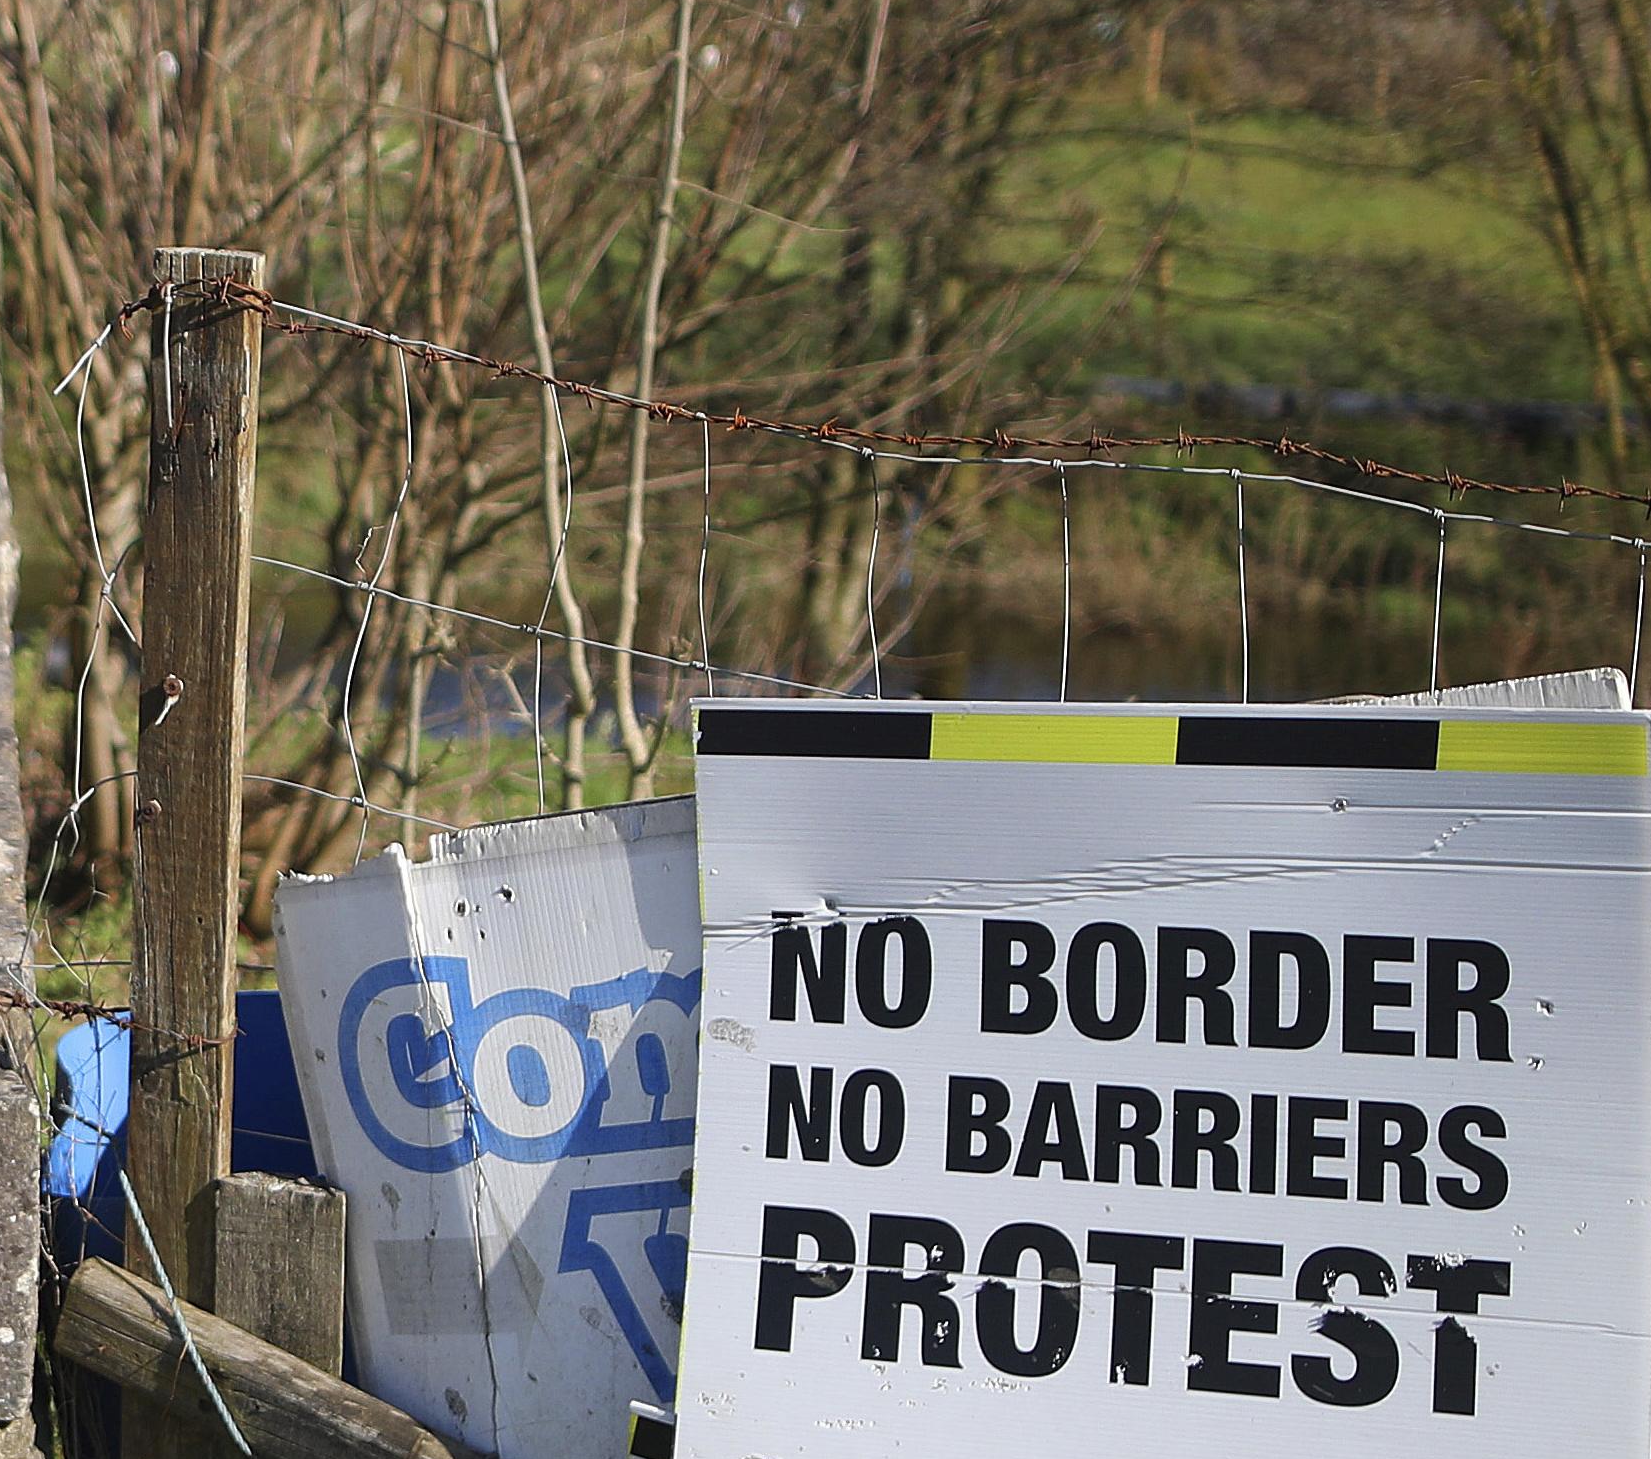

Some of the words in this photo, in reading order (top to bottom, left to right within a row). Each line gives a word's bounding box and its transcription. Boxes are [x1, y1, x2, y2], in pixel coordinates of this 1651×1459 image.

[768, 910, 933, 1030] NO
[980, 917, 1515, 1064] BORDER
[765, 1063, 905, 1168] NO
[945, 1074, 1510, 1212] BARRIERS
[754, 1205, 1512, 1417] PROTEST
